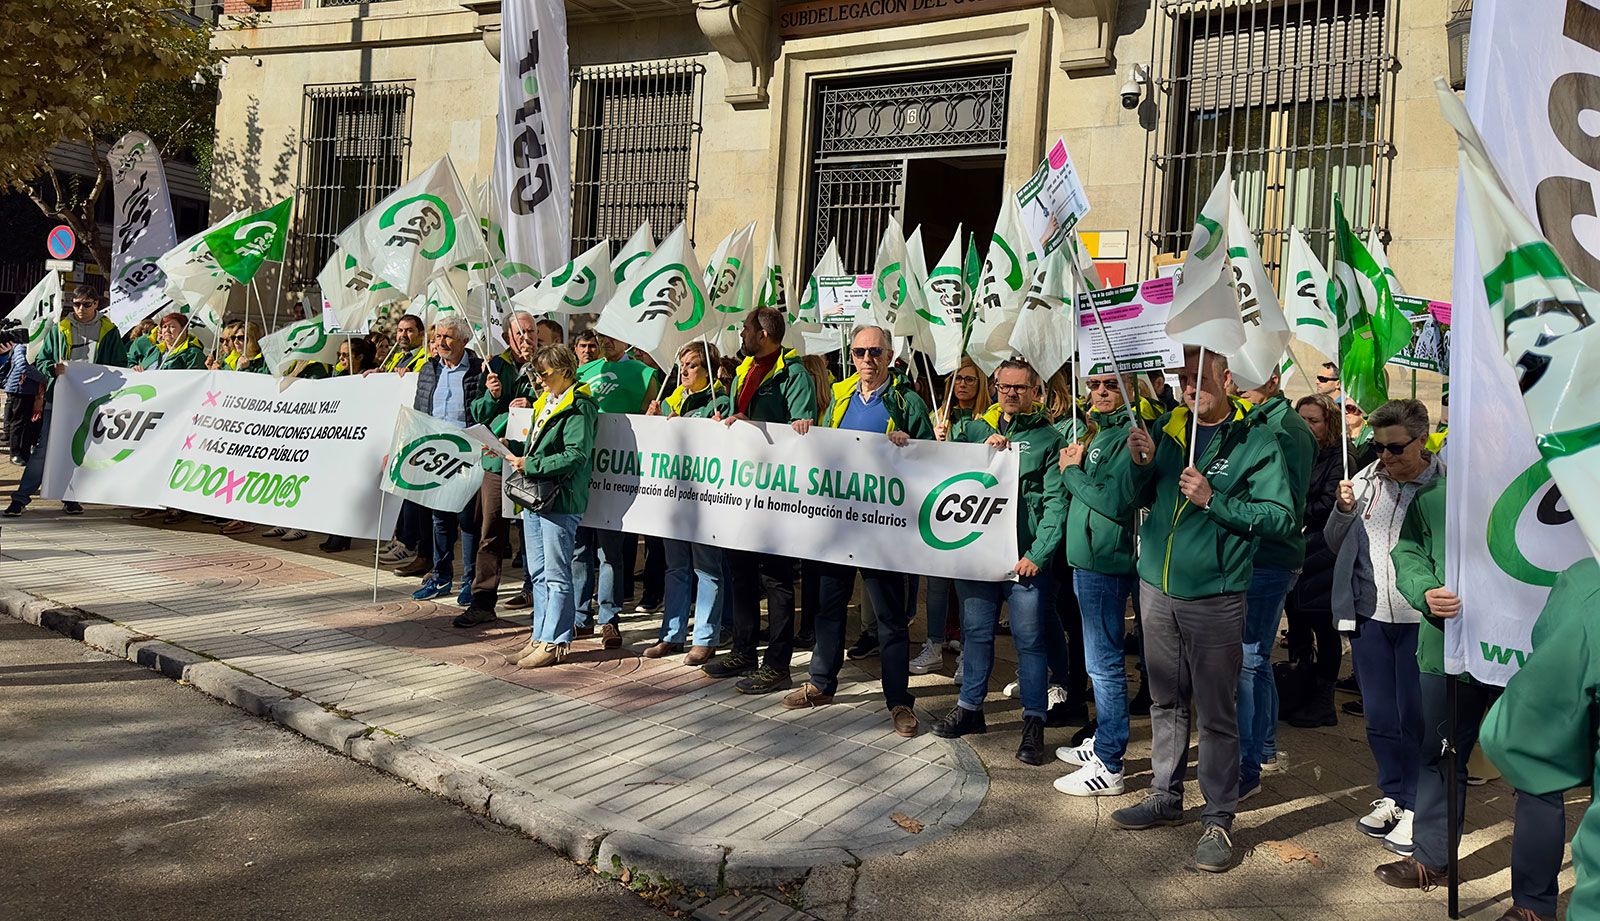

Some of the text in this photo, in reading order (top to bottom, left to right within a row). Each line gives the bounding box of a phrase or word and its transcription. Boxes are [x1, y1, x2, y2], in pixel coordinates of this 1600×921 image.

[908, 110, 915, 122] 6
[273, 401, 319, 414] SALARIAL
[319, 400, 341, 414] YA!!!
[92, 408, 165, 441] CSIF
[194, 413, 368, 440] MEJORES CONDICIONES LABORALES
[198, 437, 309, 463] MÁS EMPLEO PÚBLICO
[408, 447, 474, 479] CSIF
[591, 448, 905, 507] IGUAL TRABAJO, IGUAL SALARIO
[603, 478, 611, 489] la
[613, 481, 662, 497] recuperación
[664, 485, 676, 498] del
[679, 487, 699, 502] poder
[700, 492, 742, 506] adquisitivo
[745, 499, 751, 510] y
[753, 495, 764, 509] la
[767, 496, 842, 519] homologación
[846, 507, 859, 521] de
[862, 509, 907, 528] salarios
[935, 493, 1009, 525] CSIF
